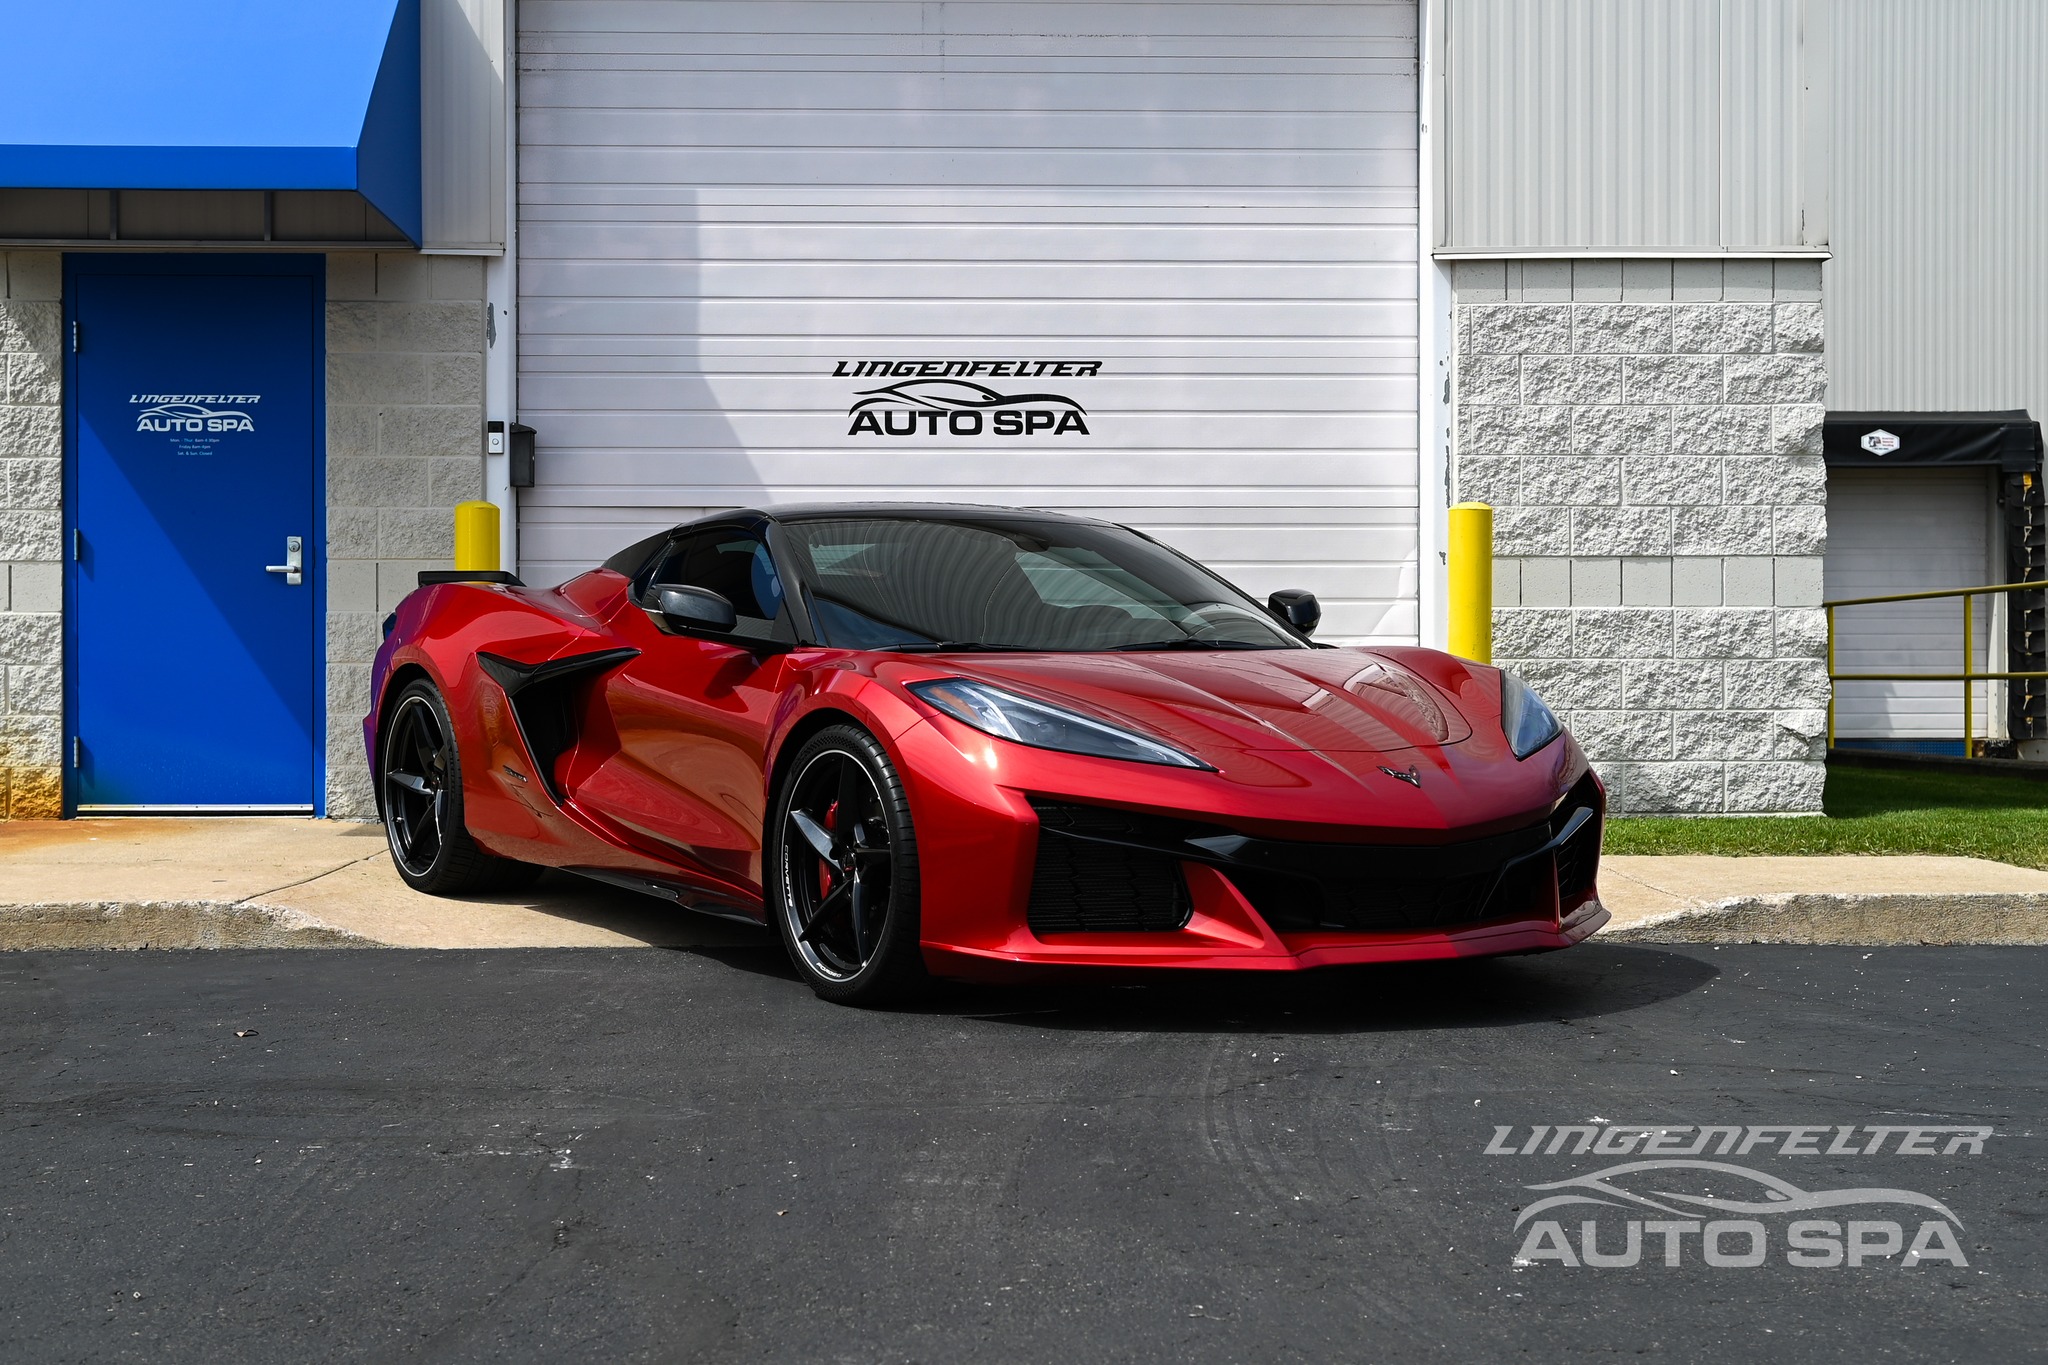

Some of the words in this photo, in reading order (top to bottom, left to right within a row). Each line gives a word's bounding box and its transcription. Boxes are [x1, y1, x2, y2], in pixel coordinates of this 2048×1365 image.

[832, 361, 1103, 376] LINGENFELTER
[129, 394, 261, 403] LINGENFELTER
[137, 419, 203, 432] AUTO
[207, 419, 255, 432] SPA
[848, 410, 983, 435] AUTO
[993, 410, 1090, 435] SPA
[785, 845, 794, 907] CORVETTE
